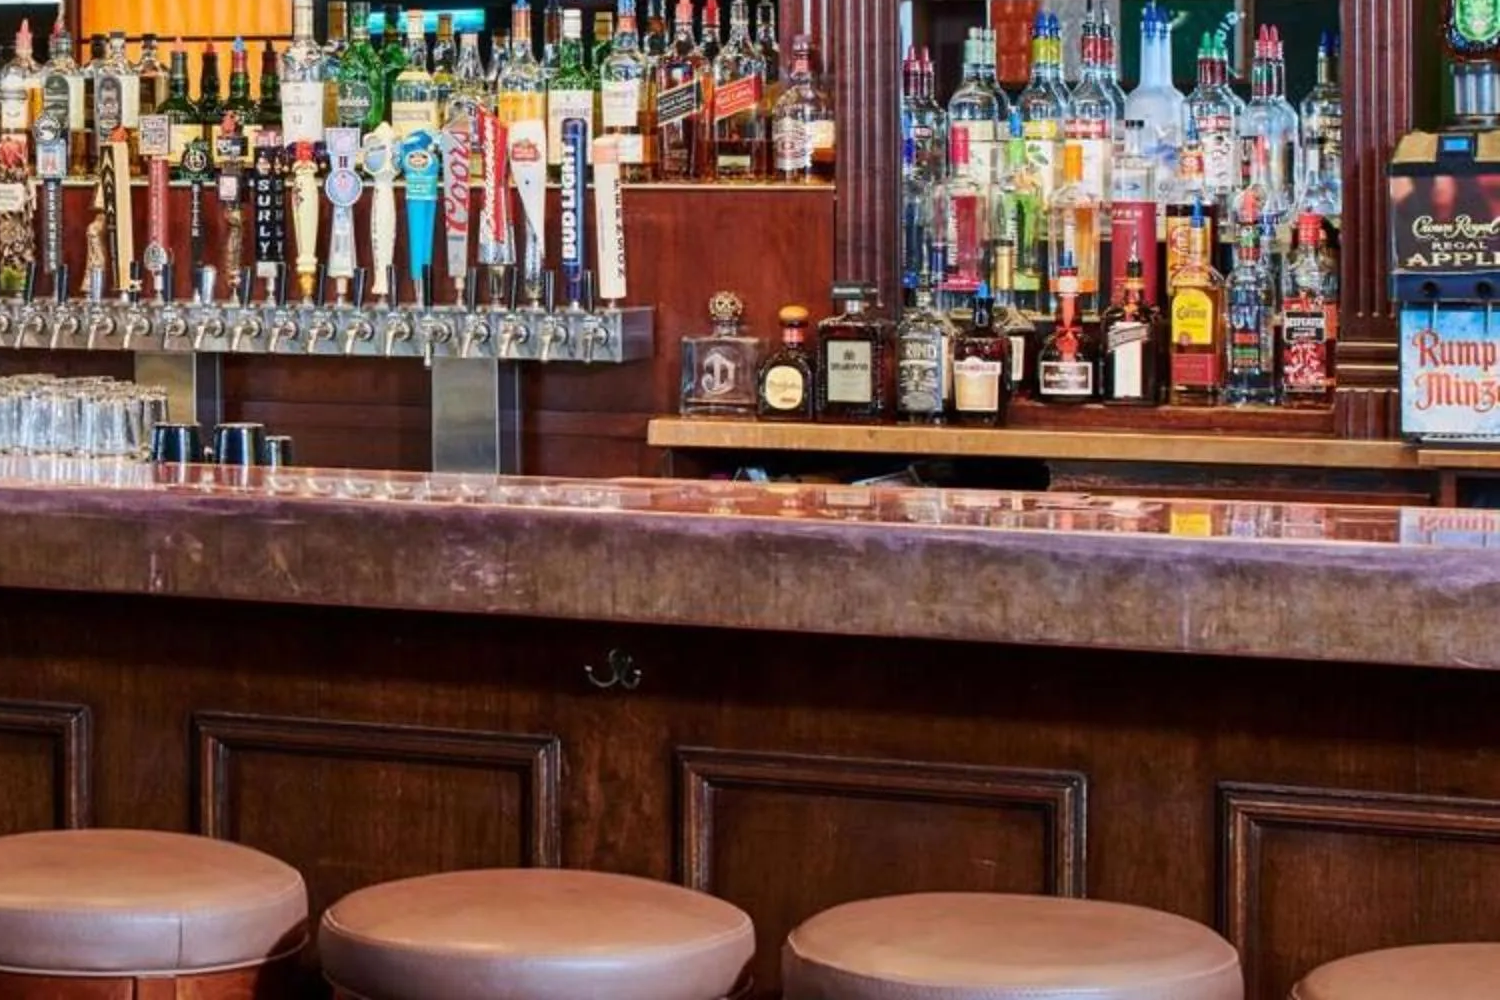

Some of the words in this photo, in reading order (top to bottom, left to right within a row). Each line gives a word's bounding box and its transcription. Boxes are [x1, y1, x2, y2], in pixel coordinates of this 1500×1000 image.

[445, 130, 470, 232] Coors
[561, 144, 577, 209] LIGHT
[257, 180, 271, 254] SURLY
[561, 212, 577, 259] BUD
[1411, 214, 1452, 240] Crown
[1451, 213, 1500, 242] Royal
[1432, 240, 1488, 251] REGAL
